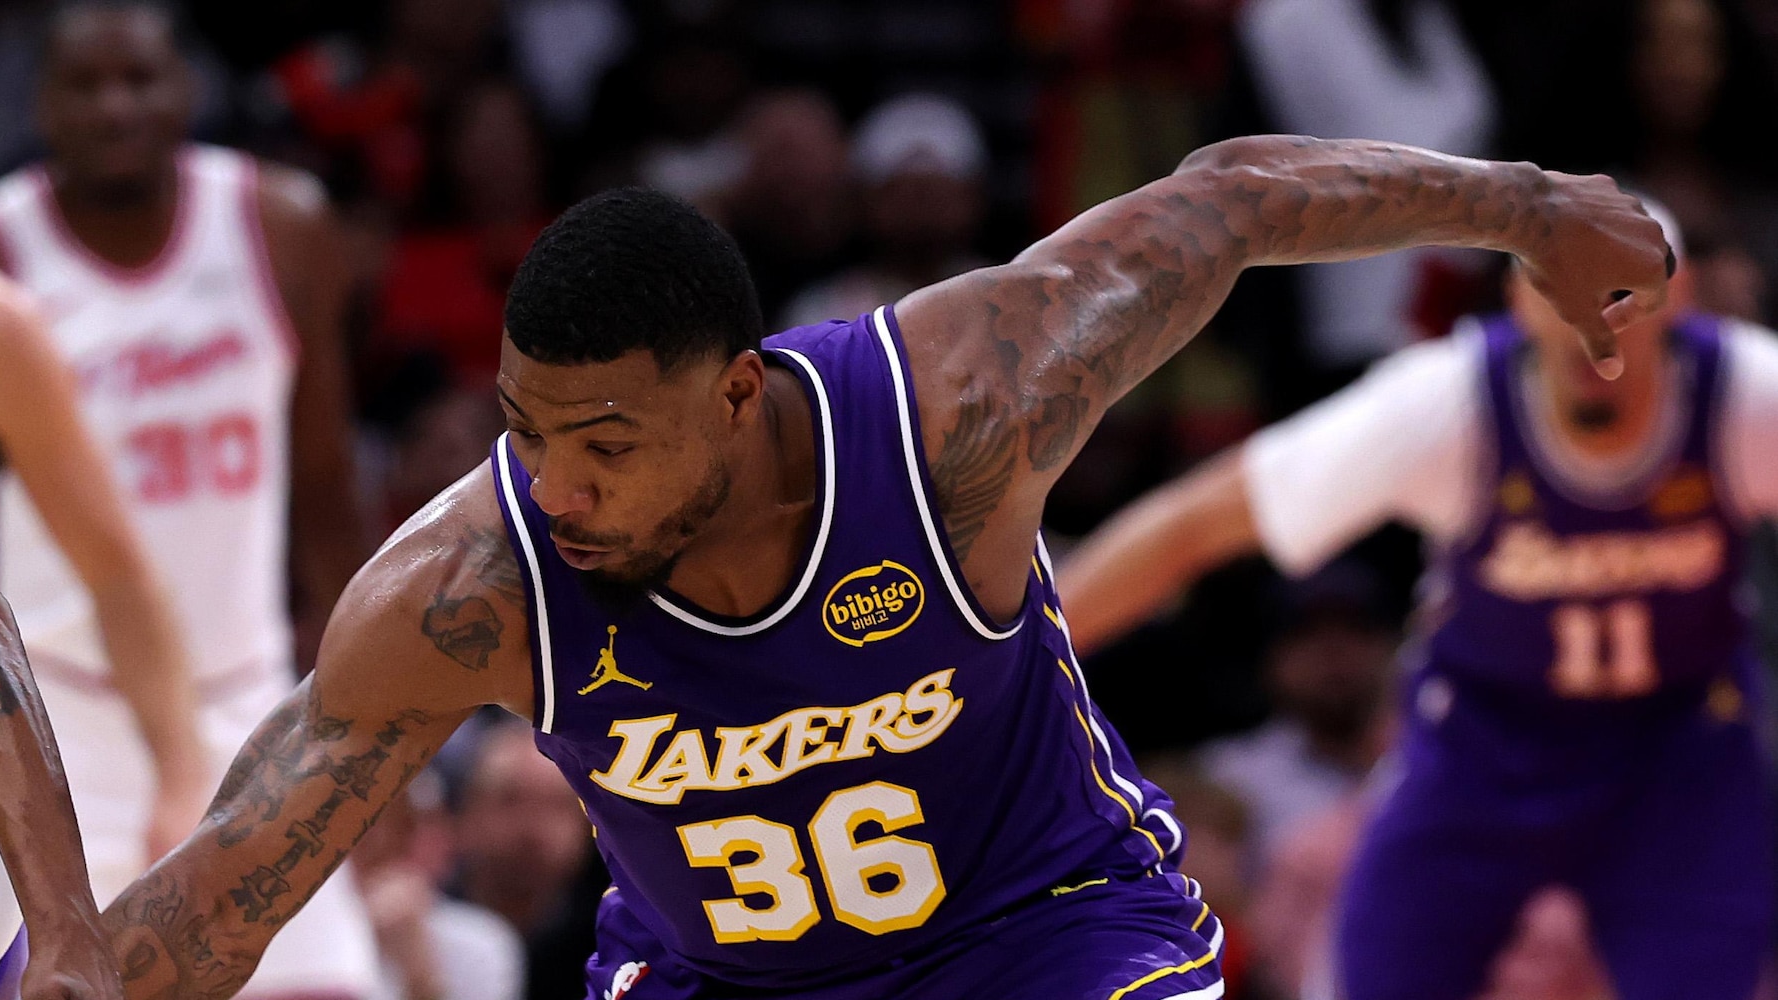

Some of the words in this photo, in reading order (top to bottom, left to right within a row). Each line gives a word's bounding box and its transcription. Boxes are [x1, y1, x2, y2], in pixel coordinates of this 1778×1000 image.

[829, 581, 917, 625] bibigo
[851, 609, 889, 631] 비비고
[1548, 601, 1658, 698] 11
[589, 667, 964, 805] LAKERS
[676, 780, 947, 944] 36
